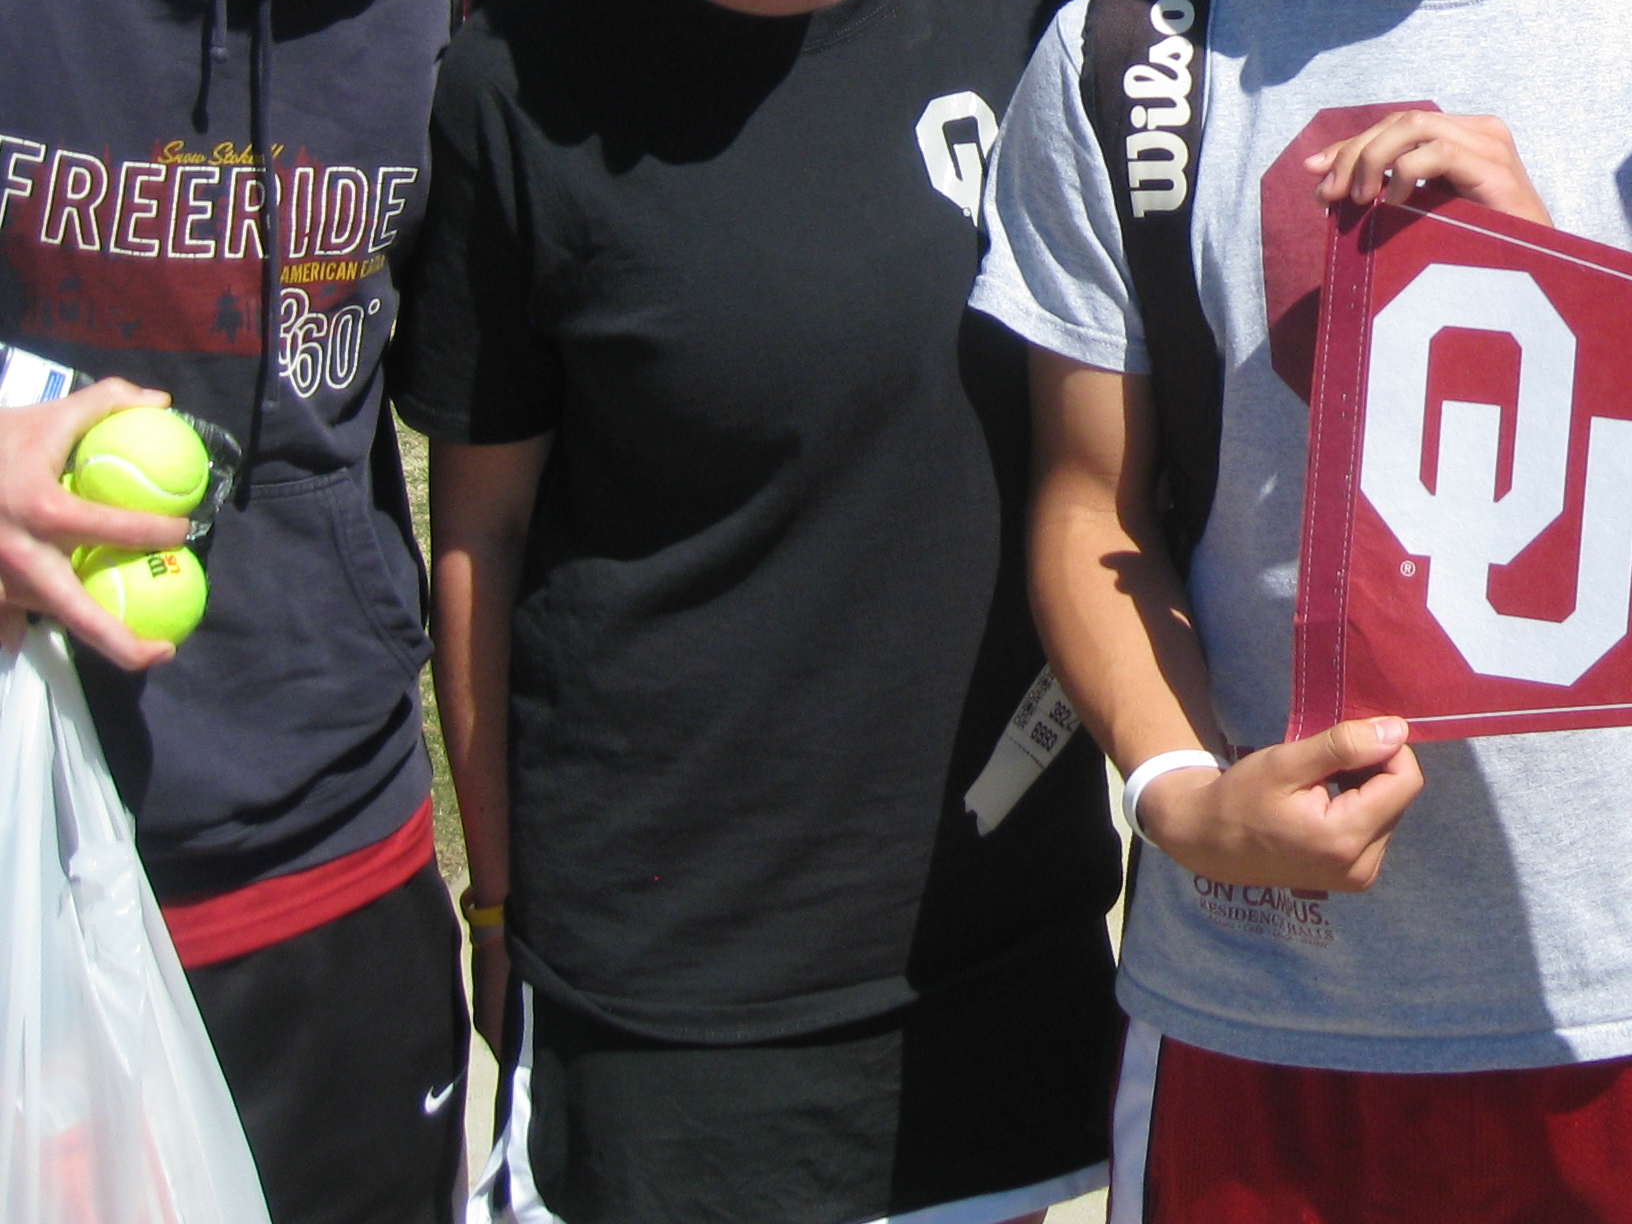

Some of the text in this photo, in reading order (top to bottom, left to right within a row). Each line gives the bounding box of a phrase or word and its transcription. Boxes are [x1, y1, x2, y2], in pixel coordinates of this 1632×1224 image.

[0, 134, 419, 260] FREERIDE
[280, 260, 359, 285] AMERICAN
[1194, 876, 1233, 902] ON
